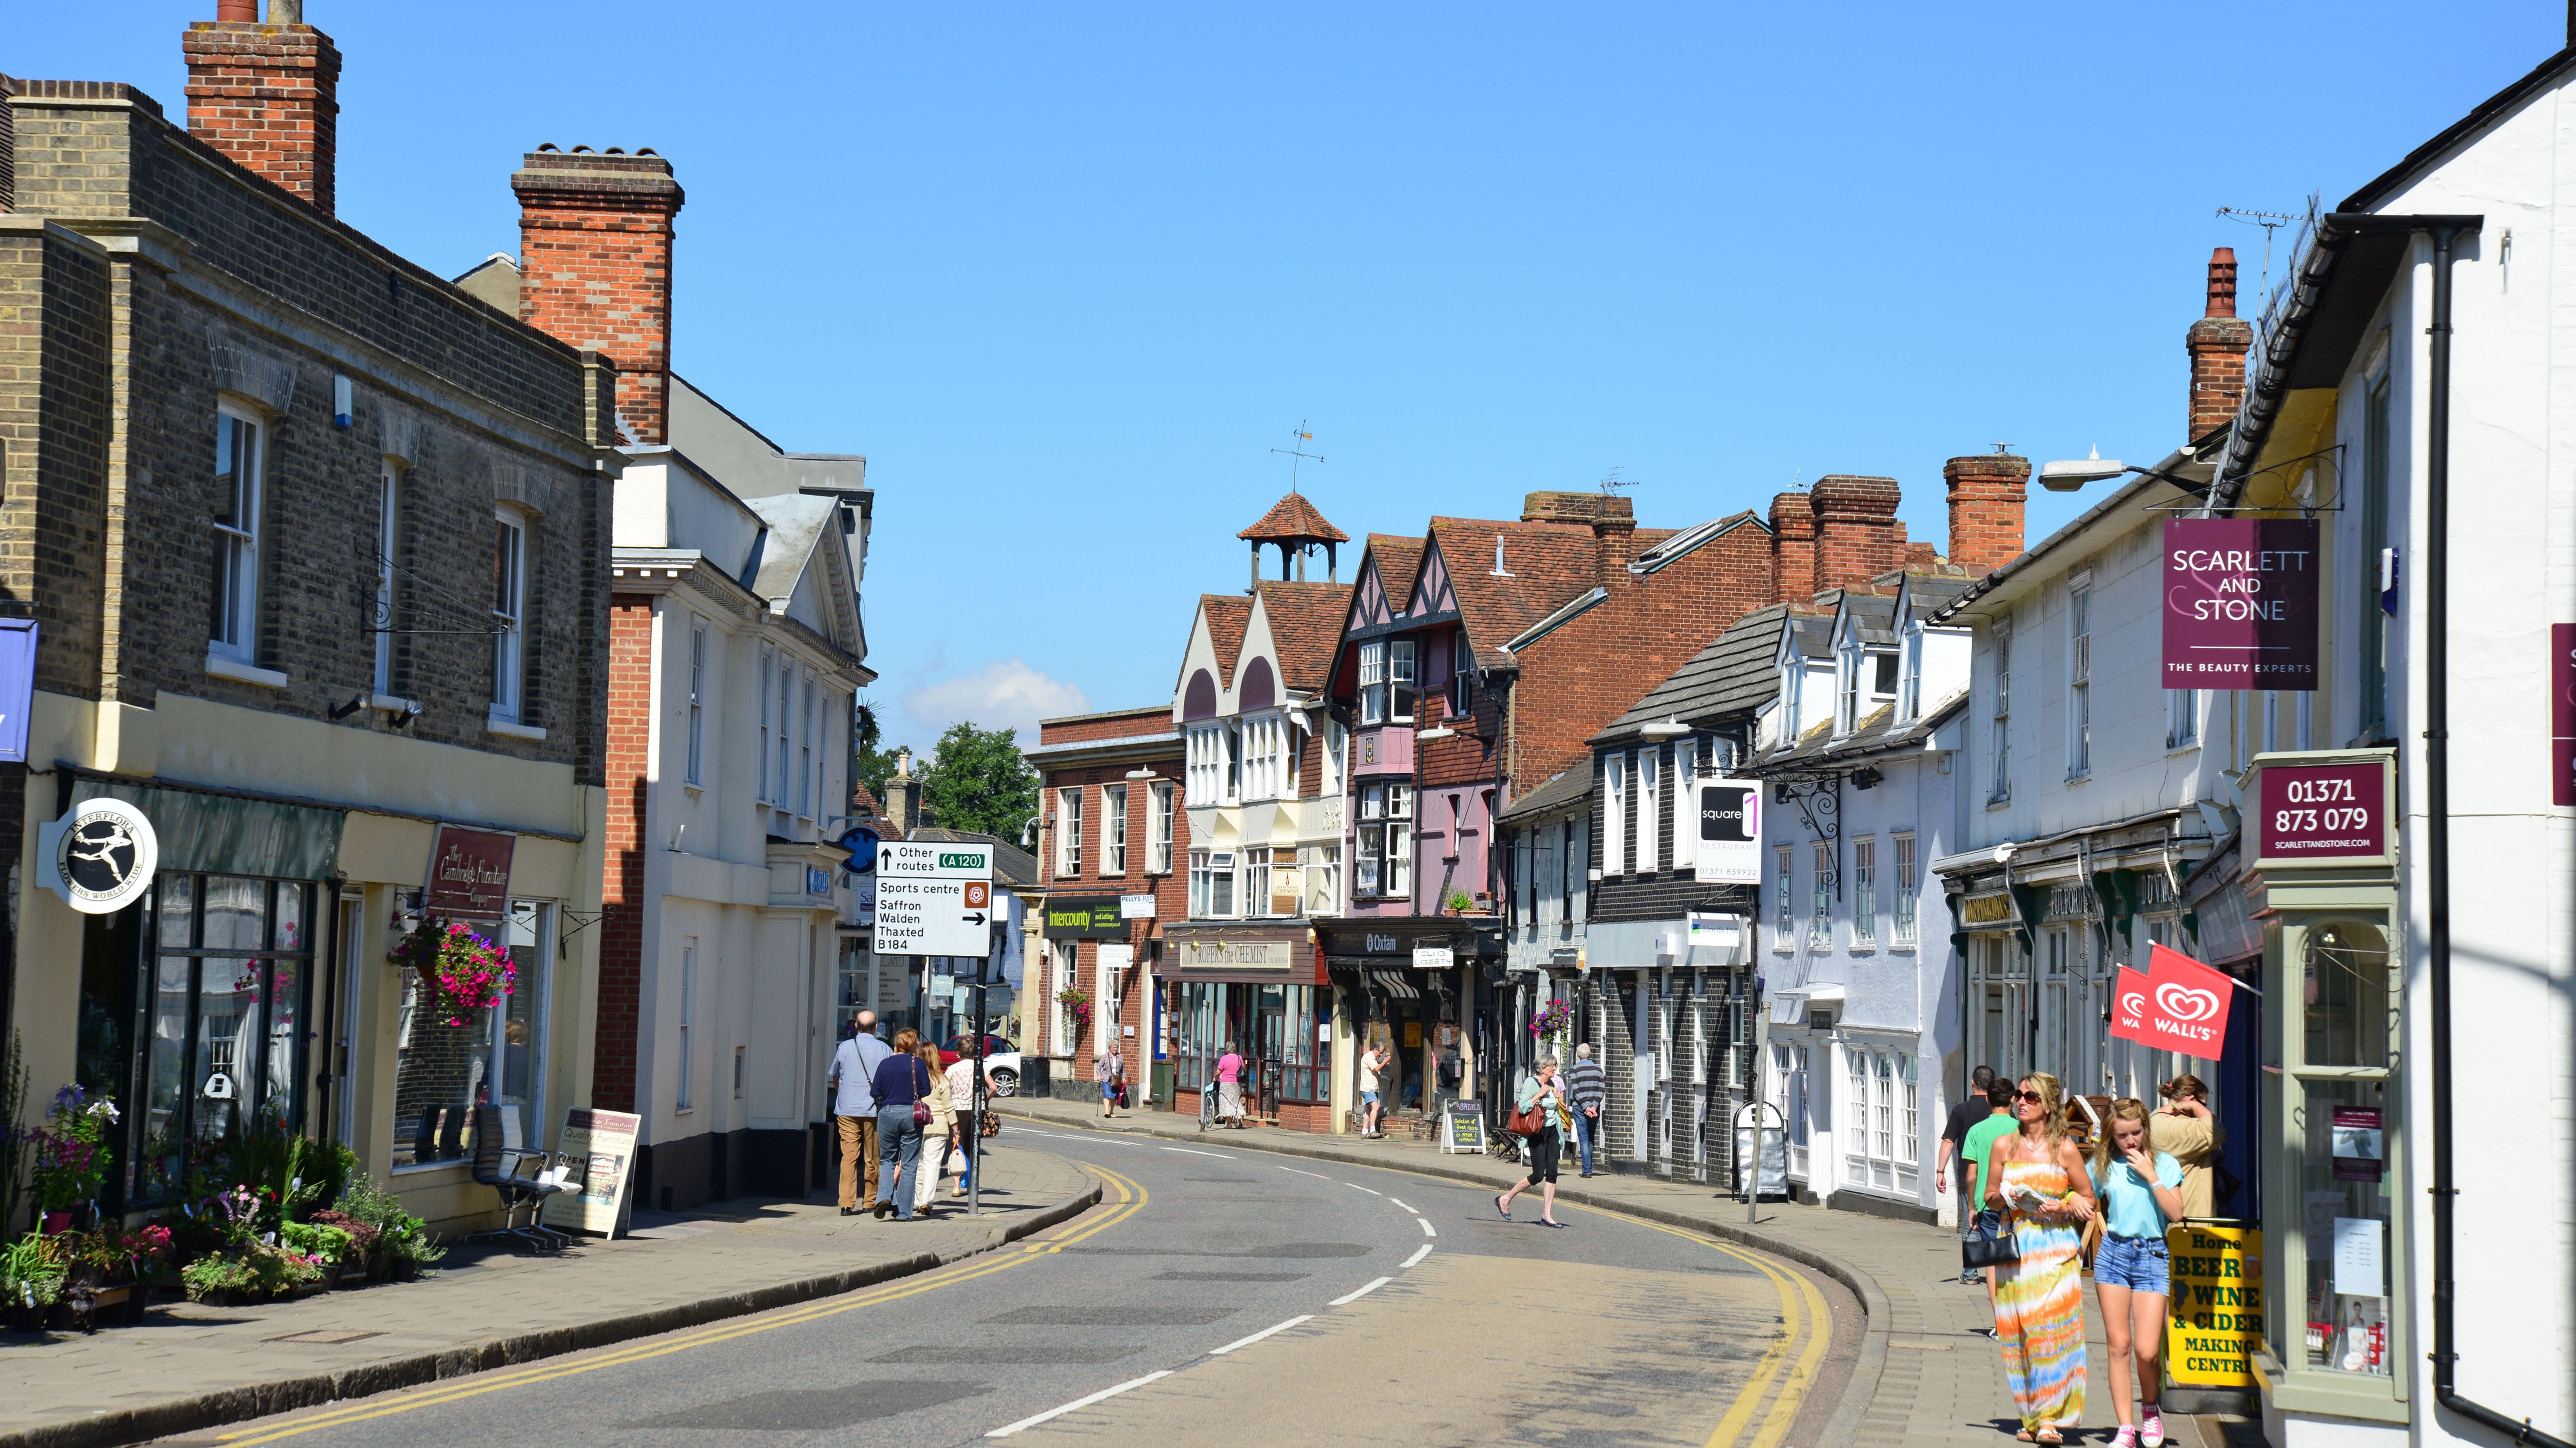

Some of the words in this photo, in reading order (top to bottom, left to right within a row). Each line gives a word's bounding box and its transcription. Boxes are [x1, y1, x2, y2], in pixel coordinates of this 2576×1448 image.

[2173, 550, 2309, 571] SCARLETT
[2219, 578, 2261, 593] AND
[2194, 599, 2286, 621] STONE
[2168, 663, 2193, 672] THE
[2199, 663, 2249, 672] BEAUTY
[2255, 664, 2311, 673] EXPERTS
[2288, 779, 2356, 803] 01371
[70, 813, 134, 834] INTERFLORA
[1702, 810, 1742, 820] square
[1744, 795, 1758, 835] 1
[2275, 809, 2318, 832] 873
[2324, 807, 2368, 831] 079
[449, 844, 459, 862] The
[899, 847, 933, 858] Other
[2275, 839, 2371, 849] SCARLETTANDSTONE.COM
[439, 853, 476, 890] Cambridge
[476, 859, 507, 885] Furniture
[897, 862, 934, 871] routes
[59, 861, 89, 897] FLOWERS
[93, 885, 124, 899] WORLD
[124, 863, 141, 886] WIDE
[880, 882, 919, 894] Sports
[923, 884, 959, 894] centre
[470, 887, 489, 907] Company
[879, 900, 921, 910] Saffron
[879, 913, 920, 923] Walden
[1049, 904, 1091, 931] Intercounty
[879, 926, 924, 937] Thaxted
[1703, 926, 1724, 935] Lloyds
[1374, 934, 1396, 951] Oxfam
[1198, 946, 1223, 963] ROPERS
[1225, 948, 1234, 963] the
[1235, 945, 1267, 963] CHEMIST
[2154, 1017, 2211, 1041] WALL'S
[604, 1118, 633, 1128] Furniture
[565, 1128, 594, 1143] Quality
[597, 1132, 633, 1146] Furniture
[2192, 1234, 2242, 1251] Home
[2174, 1256, 2241, 1278] BEER
[2193, 1285, 2260, 1308] WINE
[2174, 1314, 2187, 1329] &
[2194, 1312, 2264, 1333] CIDER
[2185, 1338, 2255, 1354] MAKING
